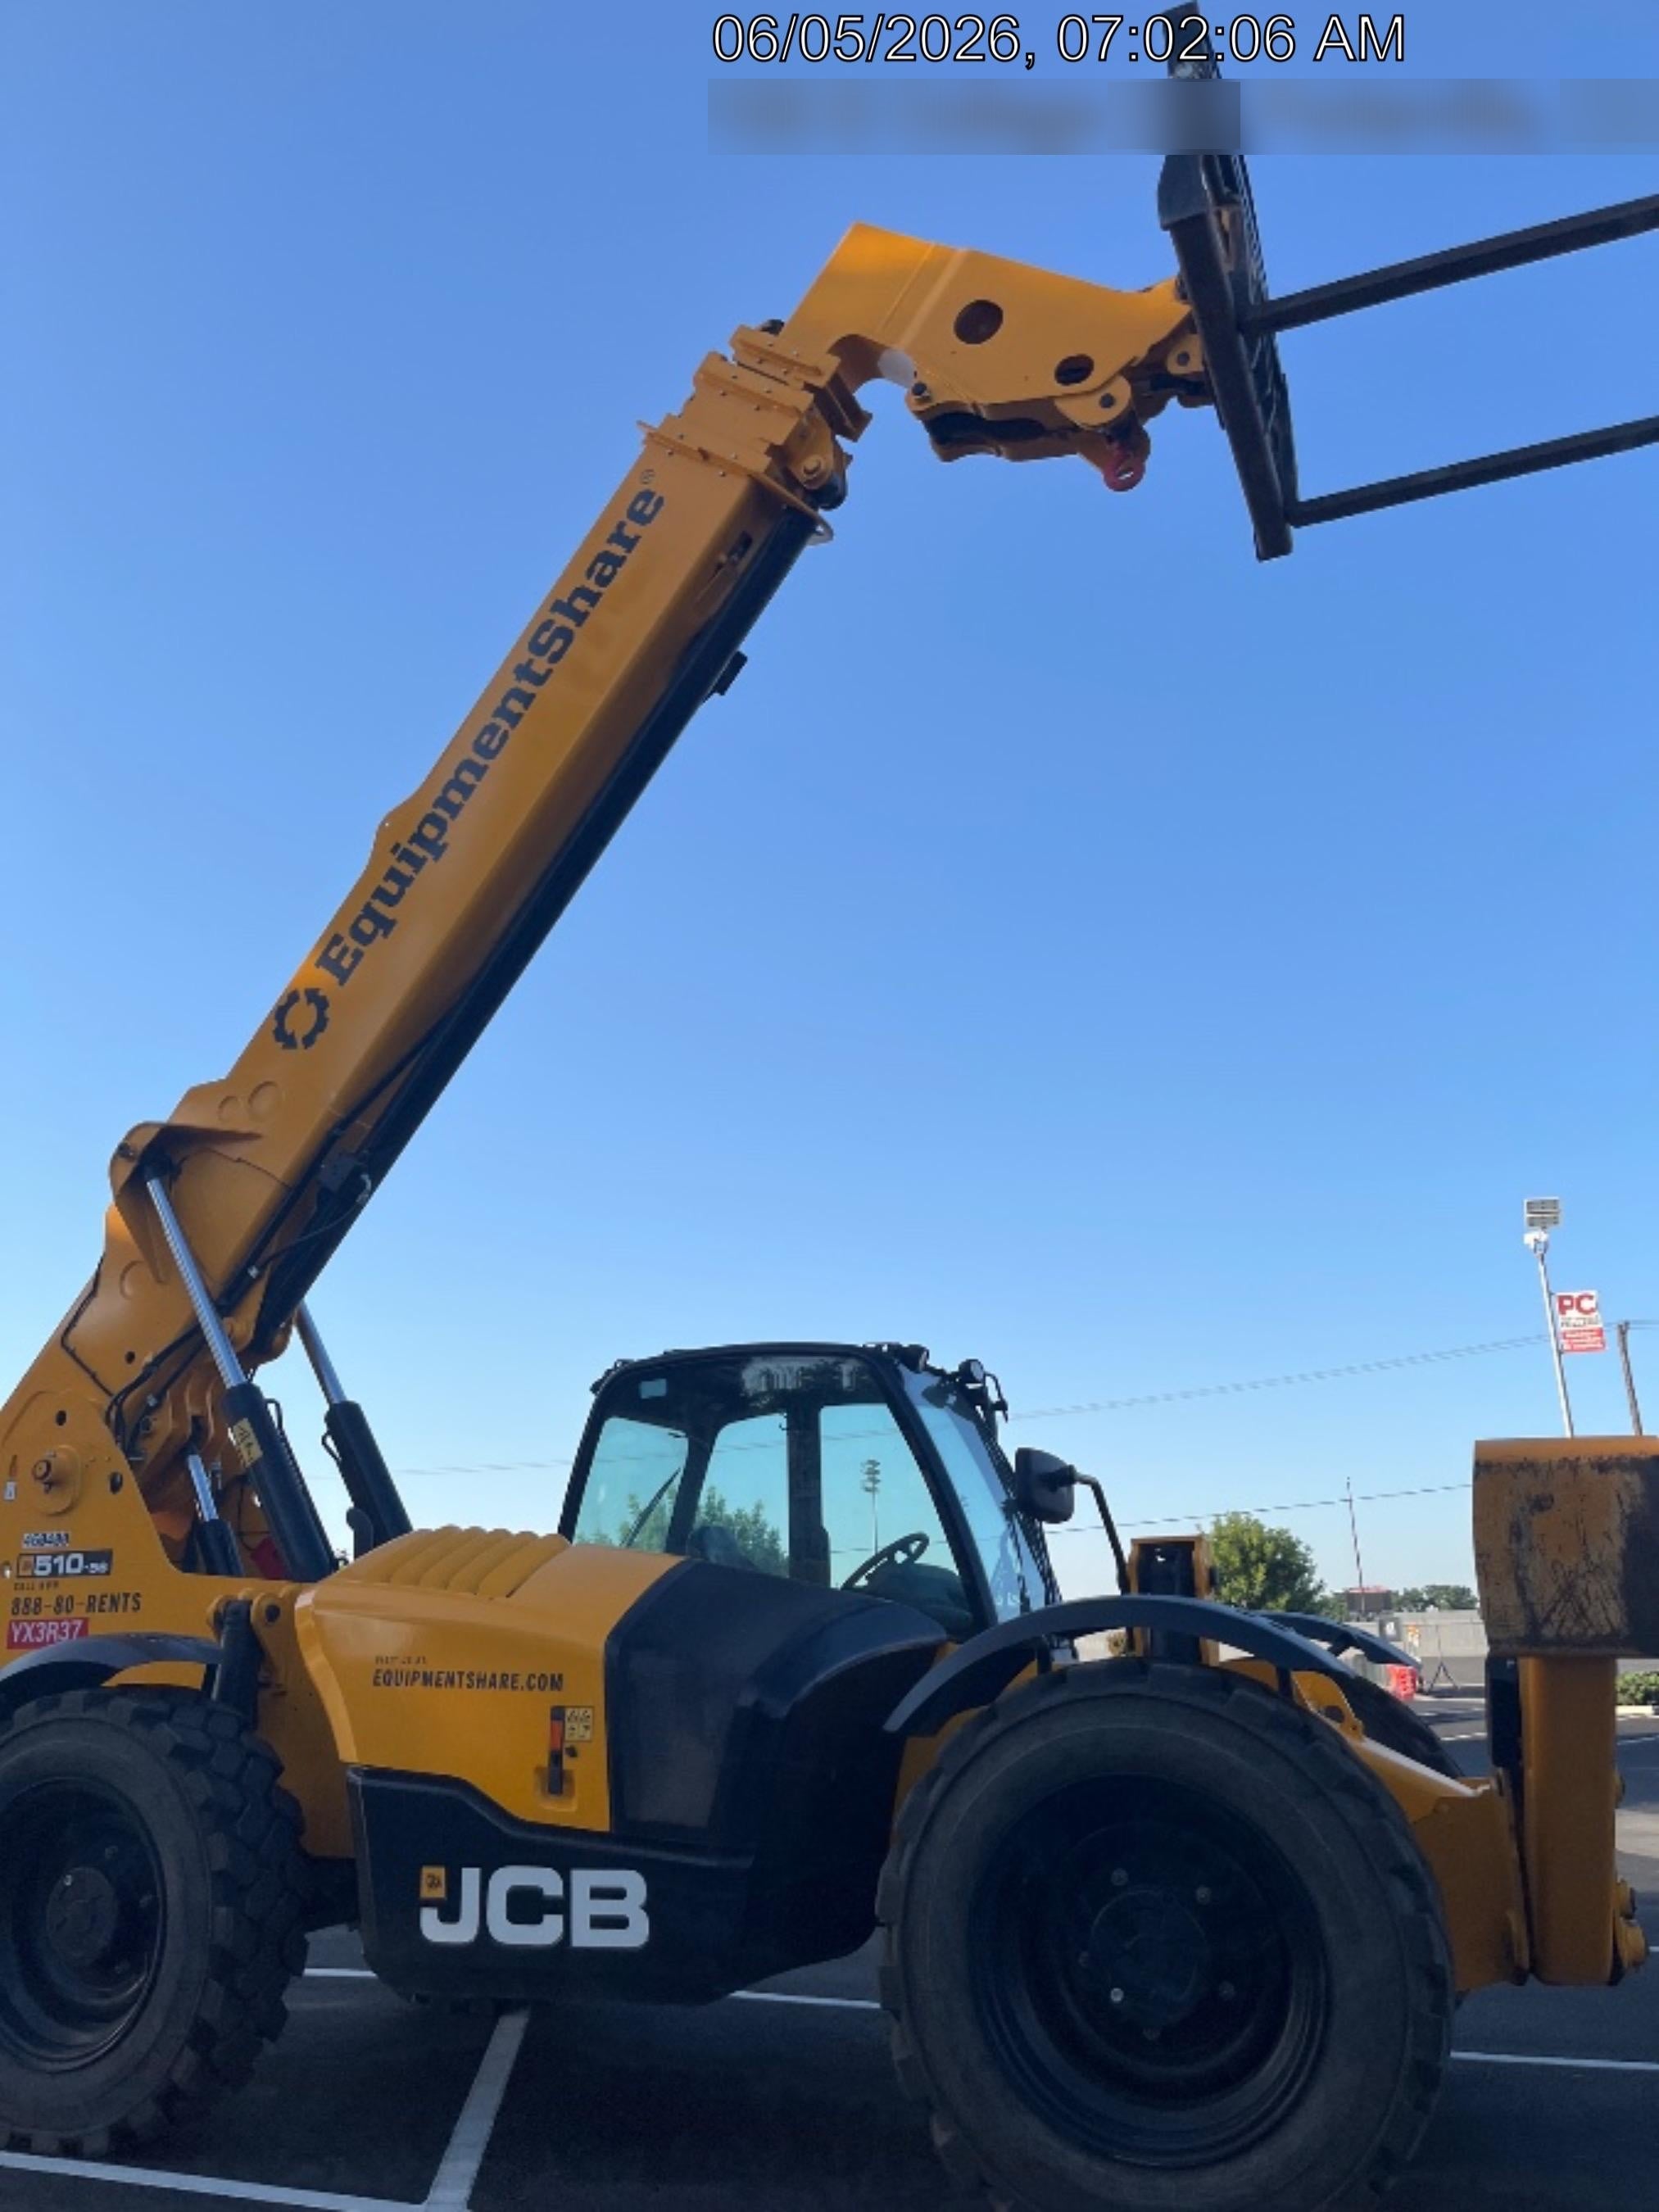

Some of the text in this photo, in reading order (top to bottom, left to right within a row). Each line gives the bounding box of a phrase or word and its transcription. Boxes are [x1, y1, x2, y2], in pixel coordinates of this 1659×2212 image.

[316, 488, 666, 986] EquipmentShare
[1557, 1294, 1597, 1315] PC
[11, 1592, 142, 1616] 888-80-RENTS
[373, 1669, 564, 1691] EQUIPMENTSHARE.COM
[419, 1865, 650, 1947] JCB
